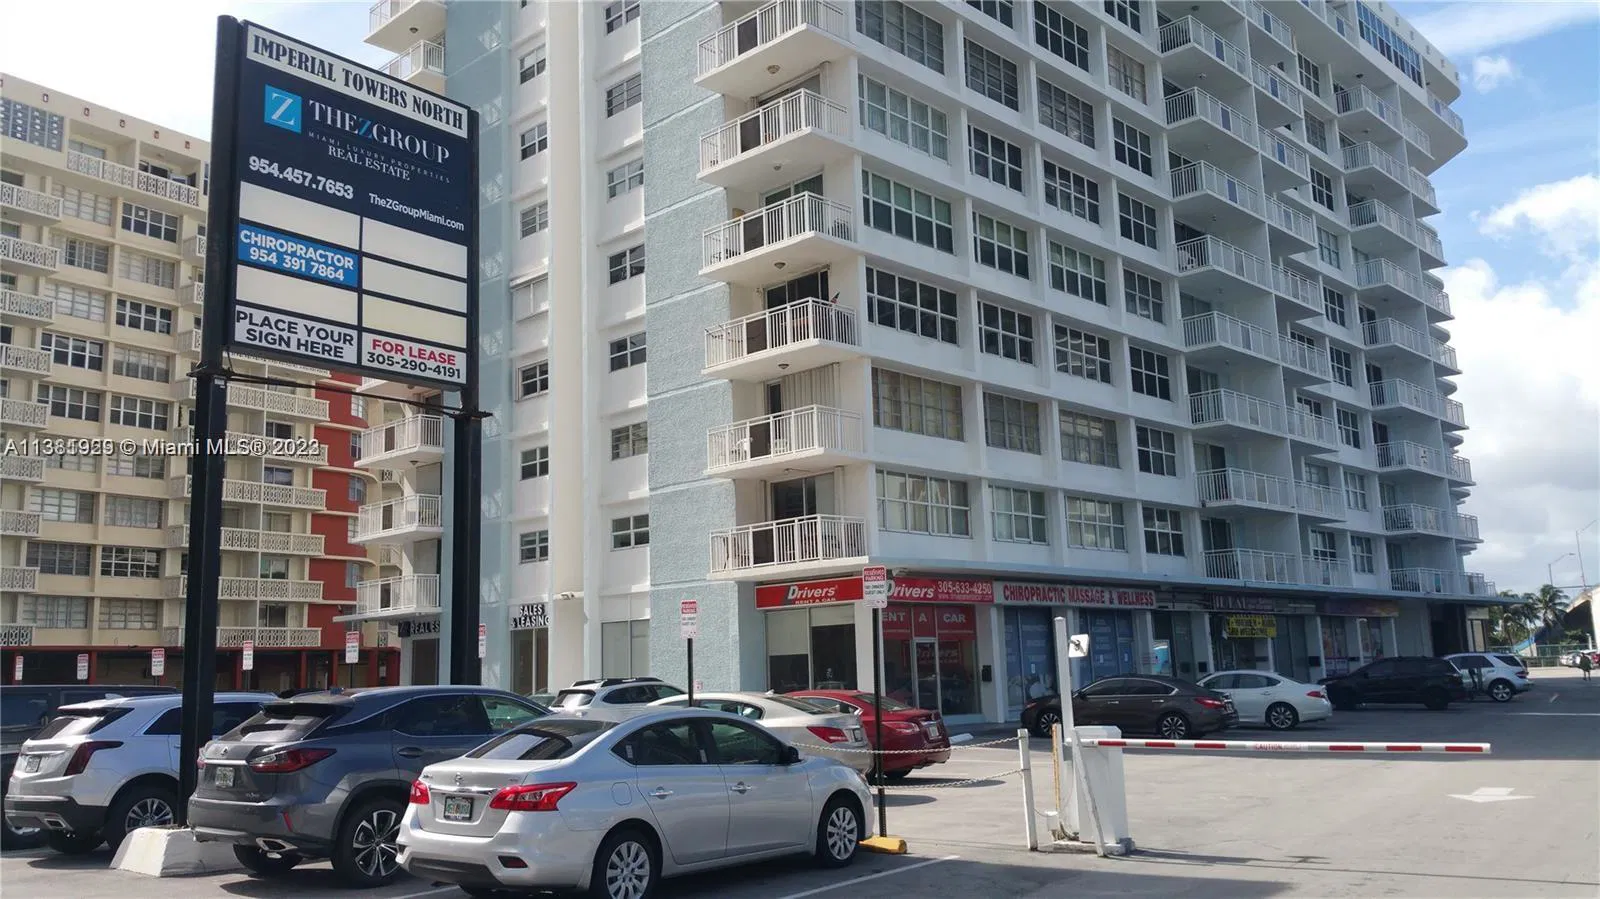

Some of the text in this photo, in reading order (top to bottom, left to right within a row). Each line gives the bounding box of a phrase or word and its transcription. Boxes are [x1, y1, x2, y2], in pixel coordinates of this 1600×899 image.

[253, 34, 463, 131] IMPERIAL TOWERS NORTH
[271, 93, 296, 126] Z
[309, 99, 450, 167] THEZGROUP
[308, 131, 451, 184] MIAMI LUXURY PROPERTIES
[328, 145, 411, 181] REAL ESTATE
[249, 155, 354, 200] 954.457.7653
[369, 193, 465, 232] TheZGroupMiami.com
[240, 229, 354, 271] CHIROPRACTOR
[250, 247, 345, 282] 954 391 7864
[236, 310, 354, 347] PLACE YOUR
[245, 328, 344, 359] SIGN HERE
[366, 351, 462, 380] 305-290-4191
[372, 338, 456, 366] FOR LEASE
[787, 584, 836, 600] Drivers
[937, 580, 992, 595] 305-633-4250
[1003, 583, 1066, 604] CHIROPRACTIC
[1068, 587, 1105, 605] MASSAGE
[1117, 590, 1154, 606] WELLNESS
[516, 613, 550, 629] LEASING
[519, 603, 543, 617] SALES
[881, 611, 966, 623] ENT A CAR
